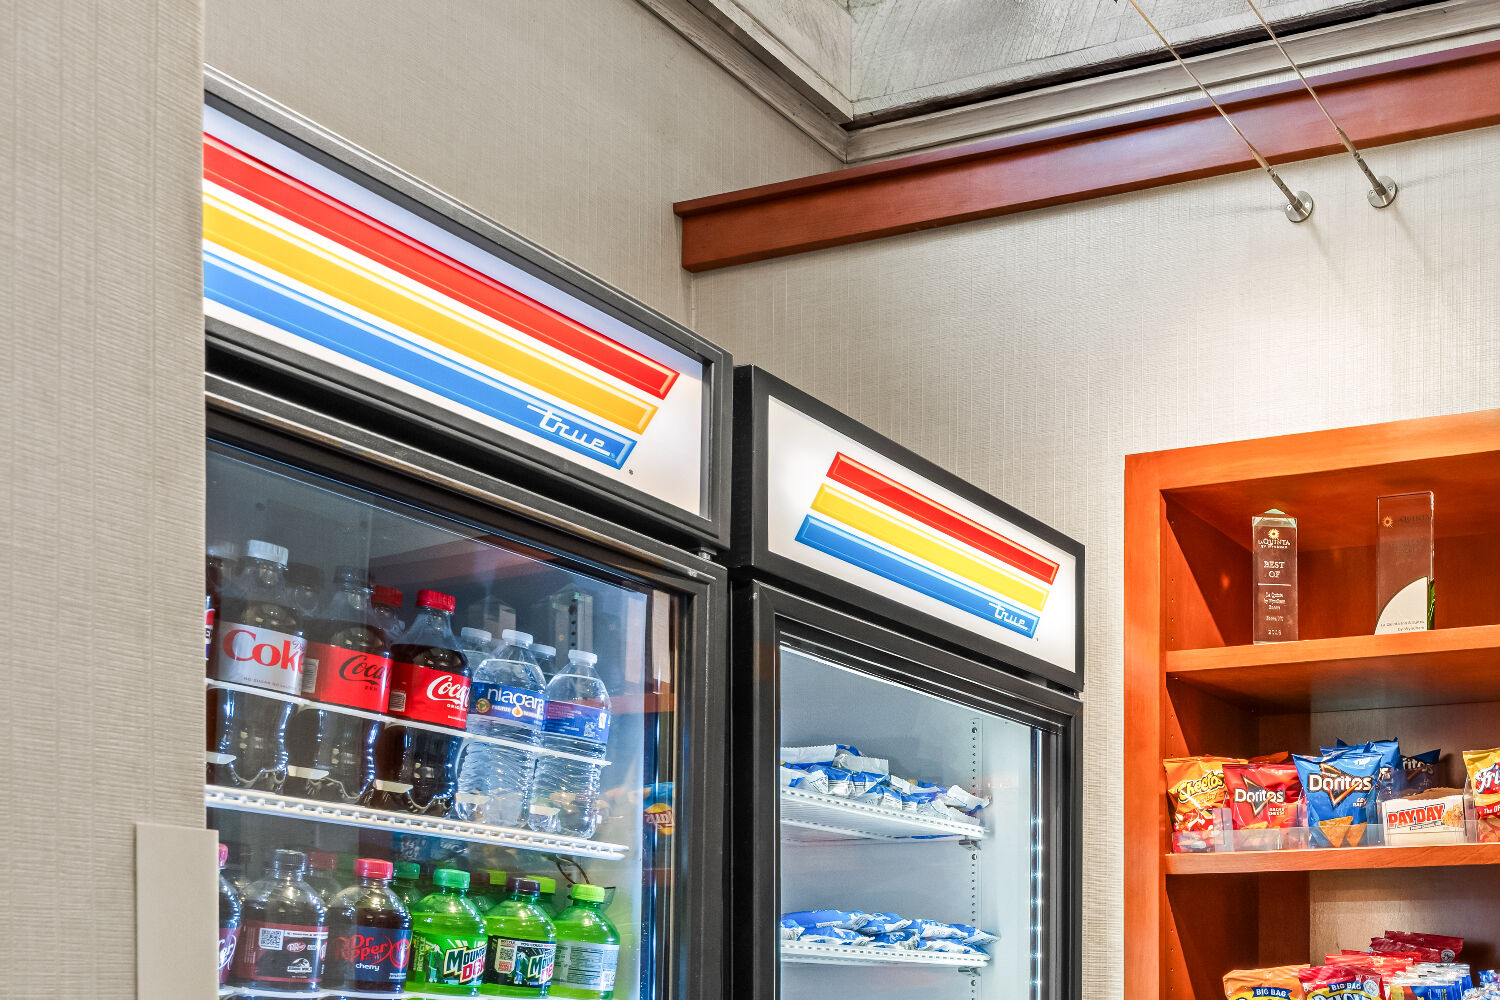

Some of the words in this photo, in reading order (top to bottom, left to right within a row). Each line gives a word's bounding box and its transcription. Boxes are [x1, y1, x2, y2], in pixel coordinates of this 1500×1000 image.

[1177, 772, 1225, 802] Cheetos
[1309, 774, 1372, 792] Doritos
[1234, 788, 1285, 802] Doritos
[1387, 803, 1445, 827] PAYDAY
[351, 934, 374, 947] Dr
[334, 936, 389, 961] Pepper
[355, 963, 380, 972] cherry
[1256, 988, 1269, 996] BIG
[1270, 989, 1286, 997] BAG
[1331, 983, 1345, 991] BIG
[1347, 981, 1362, 990] BAG
